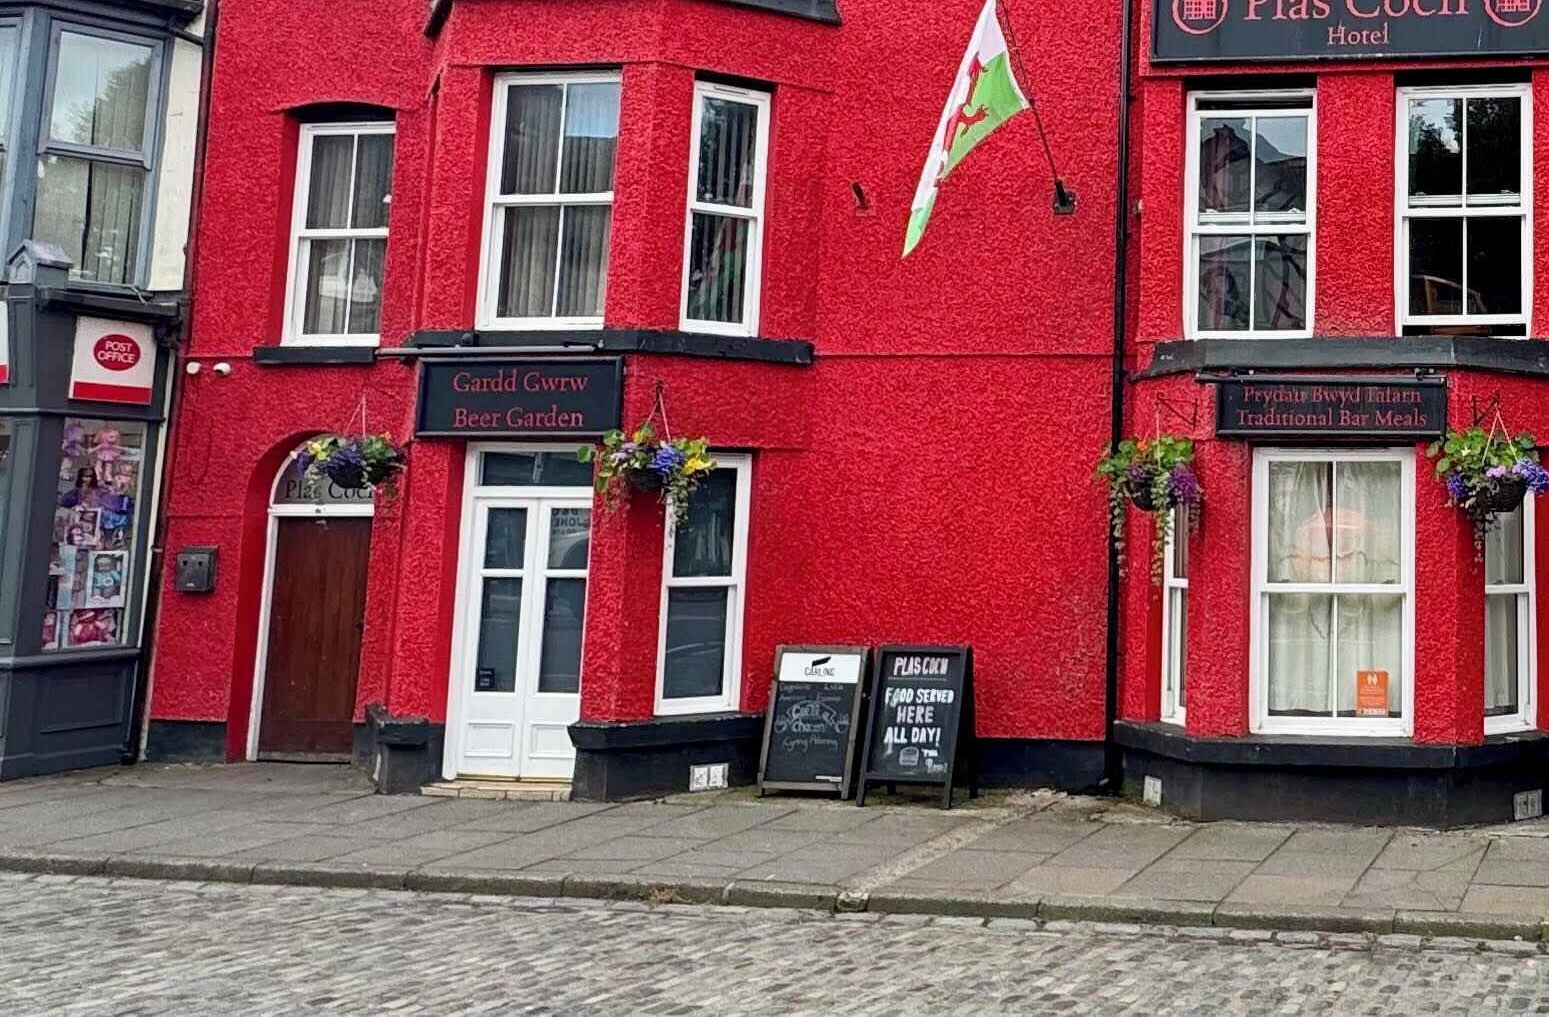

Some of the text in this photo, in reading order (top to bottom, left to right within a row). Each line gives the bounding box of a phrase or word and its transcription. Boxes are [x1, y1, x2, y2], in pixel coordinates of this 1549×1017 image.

[1326, 22, 1390, 46] Hotel
[104, 340, 133, 353] POST
[97, 350, 136, 364] OFFICE
[452, 368, 589, 393] Gardd Gwrw
[1242, 384, 1422, 408] Prydau Bwyd Tafarn
[452, 404, 584, 428] Beer Garden
[1237, 408, 1428, 427] Traditional Bar Meals
[893, 656, 949, 676] PLAS COCH
[885, 687, 954, 706] FOOD SERVED
[896, 705, 934, 723] HERE
[883, 726, 941, 748] ALL DAY!
